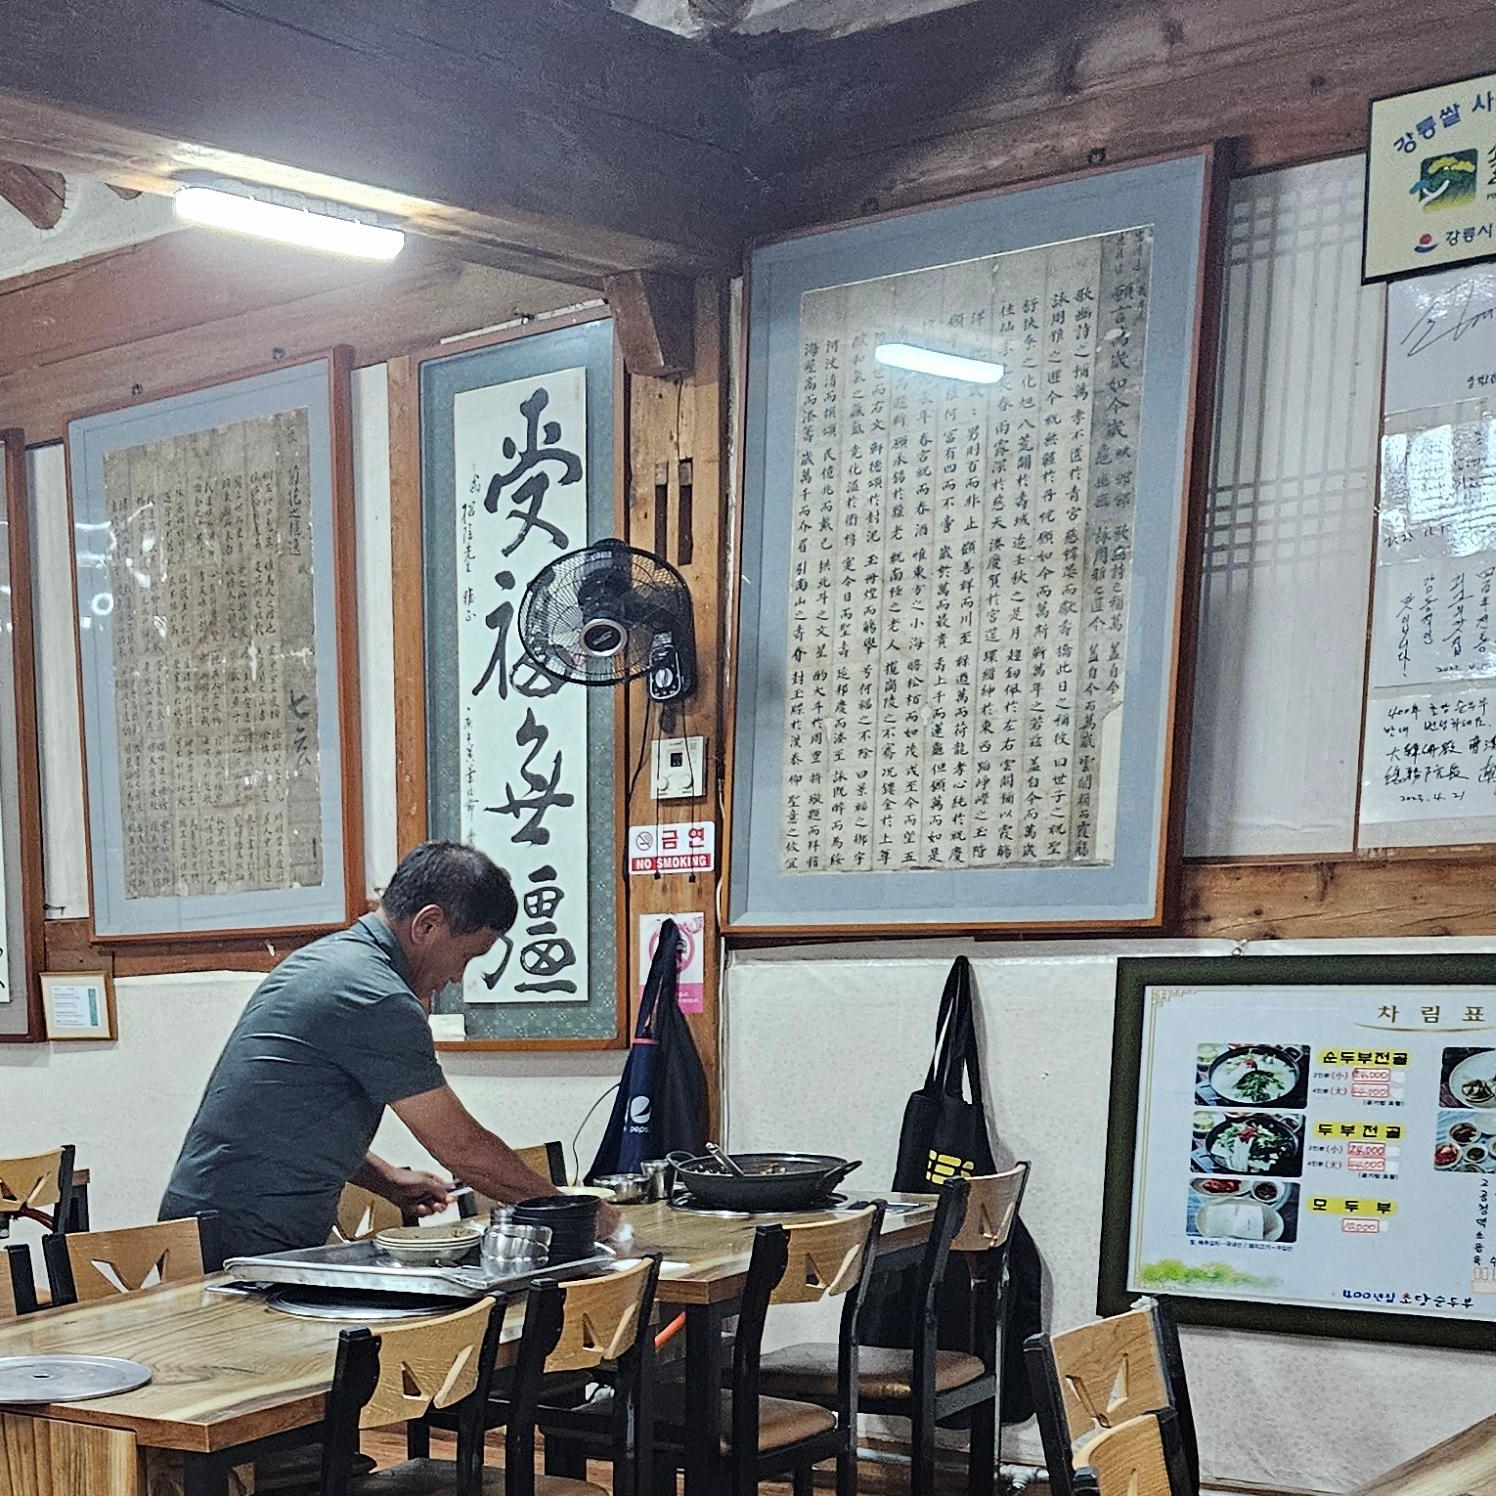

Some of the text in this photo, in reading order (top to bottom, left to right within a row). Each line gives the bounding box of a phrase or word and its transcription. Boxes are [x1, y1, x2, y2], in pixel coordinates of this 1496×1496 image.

[1393, 103, 1461, 154] 강릉쌀
[1446, 224, 1492, 246] 강릉시
[636, 854, 708, 871] NO SMOKING
[1323, 1051, 1408, 1065] 순두부전골
[1318, 1124, 1401, 1139] 두부전골
